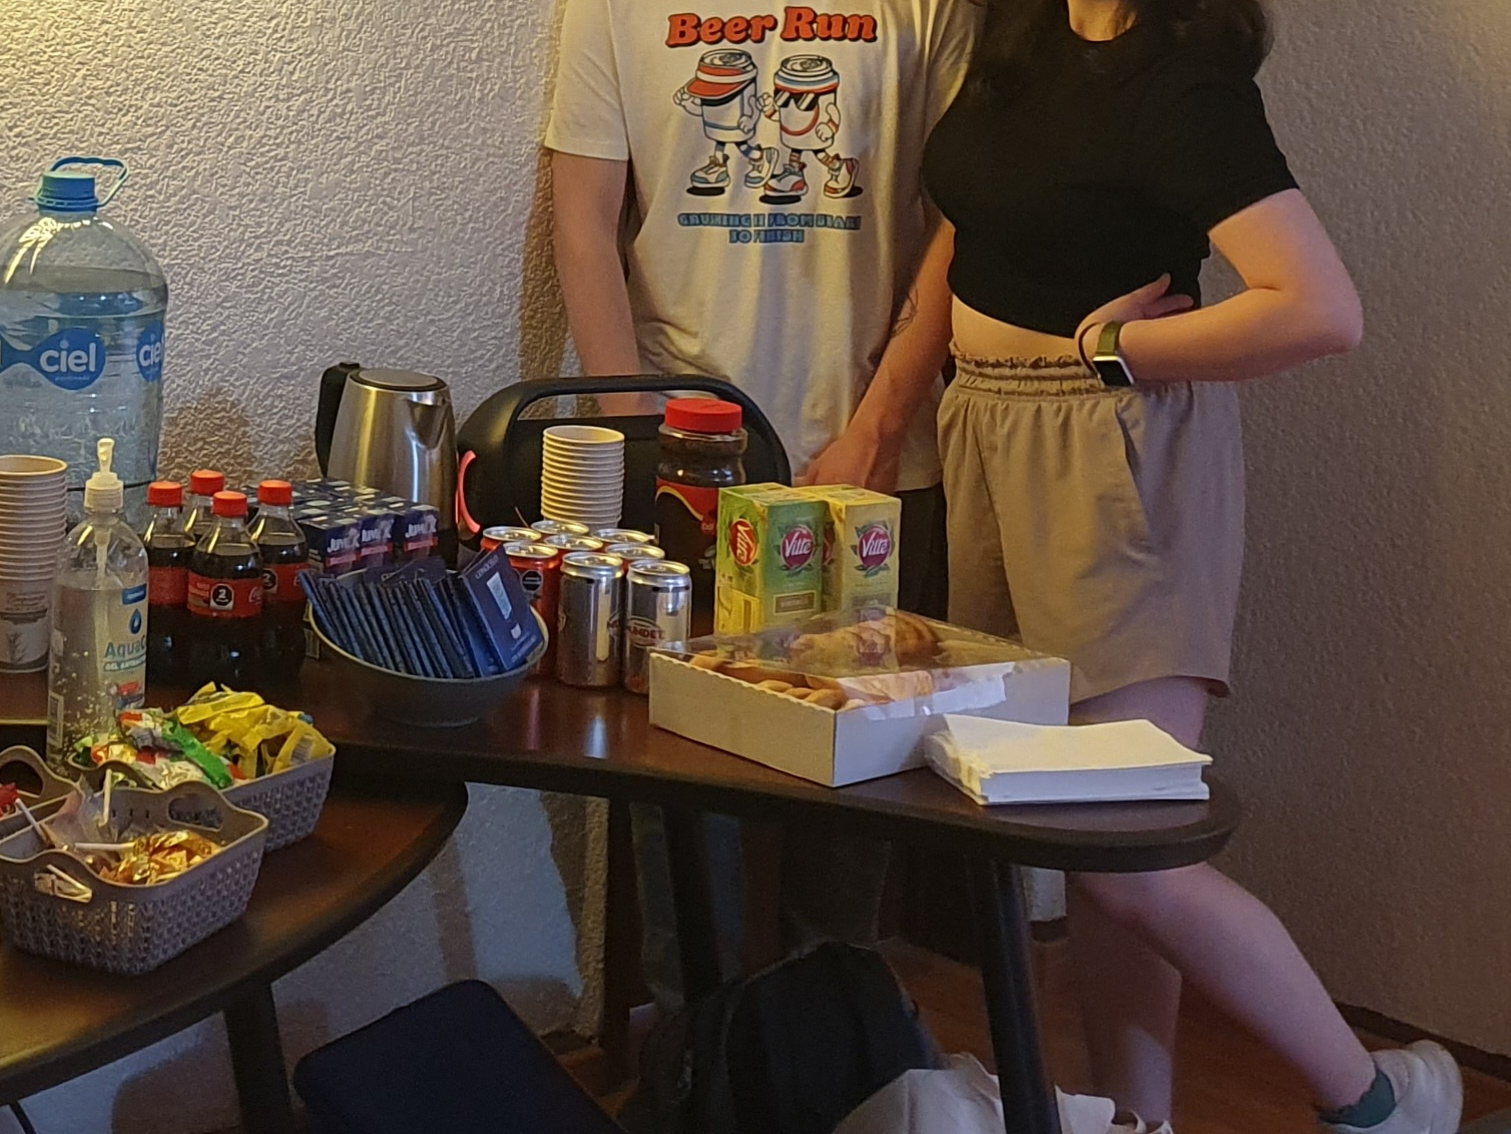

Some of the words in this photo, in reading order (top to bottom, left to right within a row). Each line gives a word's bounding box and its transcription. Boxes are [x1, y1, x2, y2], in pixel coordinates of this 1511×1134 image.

[665, 12, 778, 48] Beer
[780, 6, 879, 43] Run
[768, 213, 815, 227] FROM
[753, 229, 805, 244] FINISH
[39, 339, 97, 372] ciel
